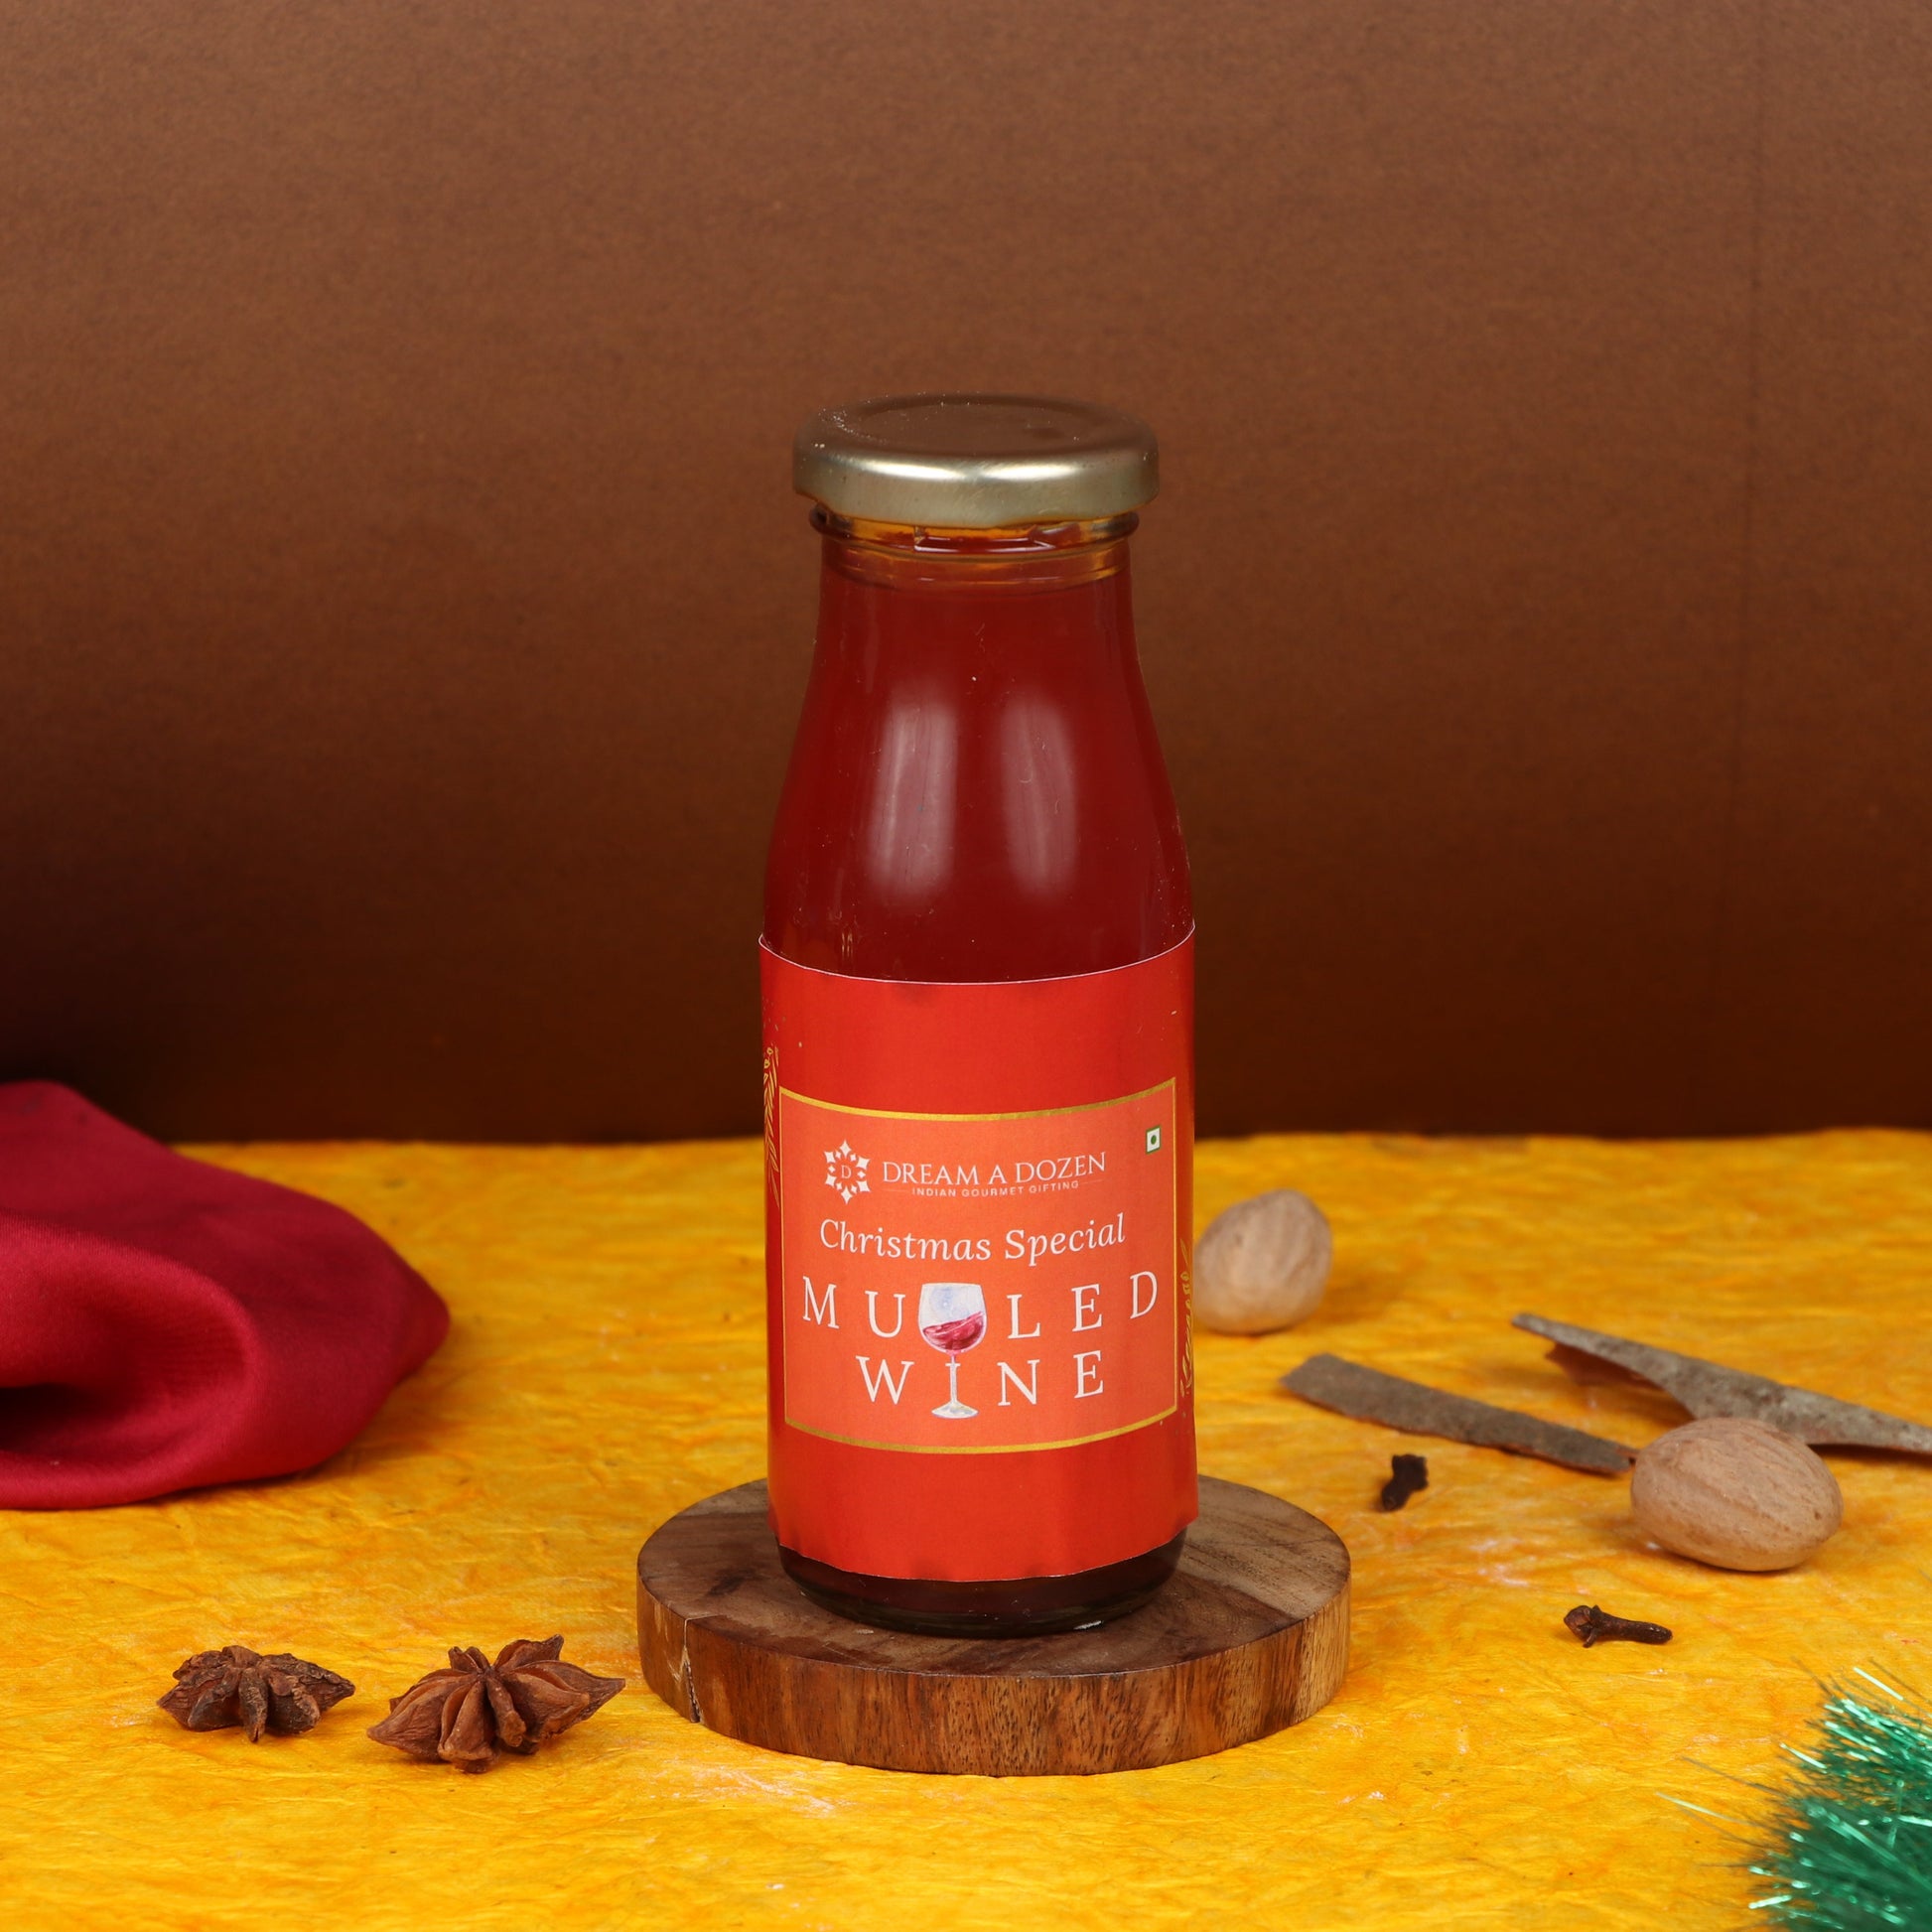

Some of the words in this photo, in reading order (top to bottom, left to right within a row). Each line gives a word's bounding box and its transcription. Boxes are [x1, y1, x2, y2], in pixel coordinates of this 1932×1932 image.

[841, 1165, 852, 1179] D
[883, 1161, 987, 1185] DREAM
[987, 1165, 1009, 1184] A
[1015, 1152, 1107, 1183] DOZEN
[911, 1186, 957, 1197] INDIAN
[961, 1185, 1026, 1198] GOURMET
[1029, 1180, 1080, 1194] GIFTING
[820, 1218, 992, 1261] Christmas
[1005, 1212, 1126, 1267] Special
[856, 1350, 1104, 1407] WINE
